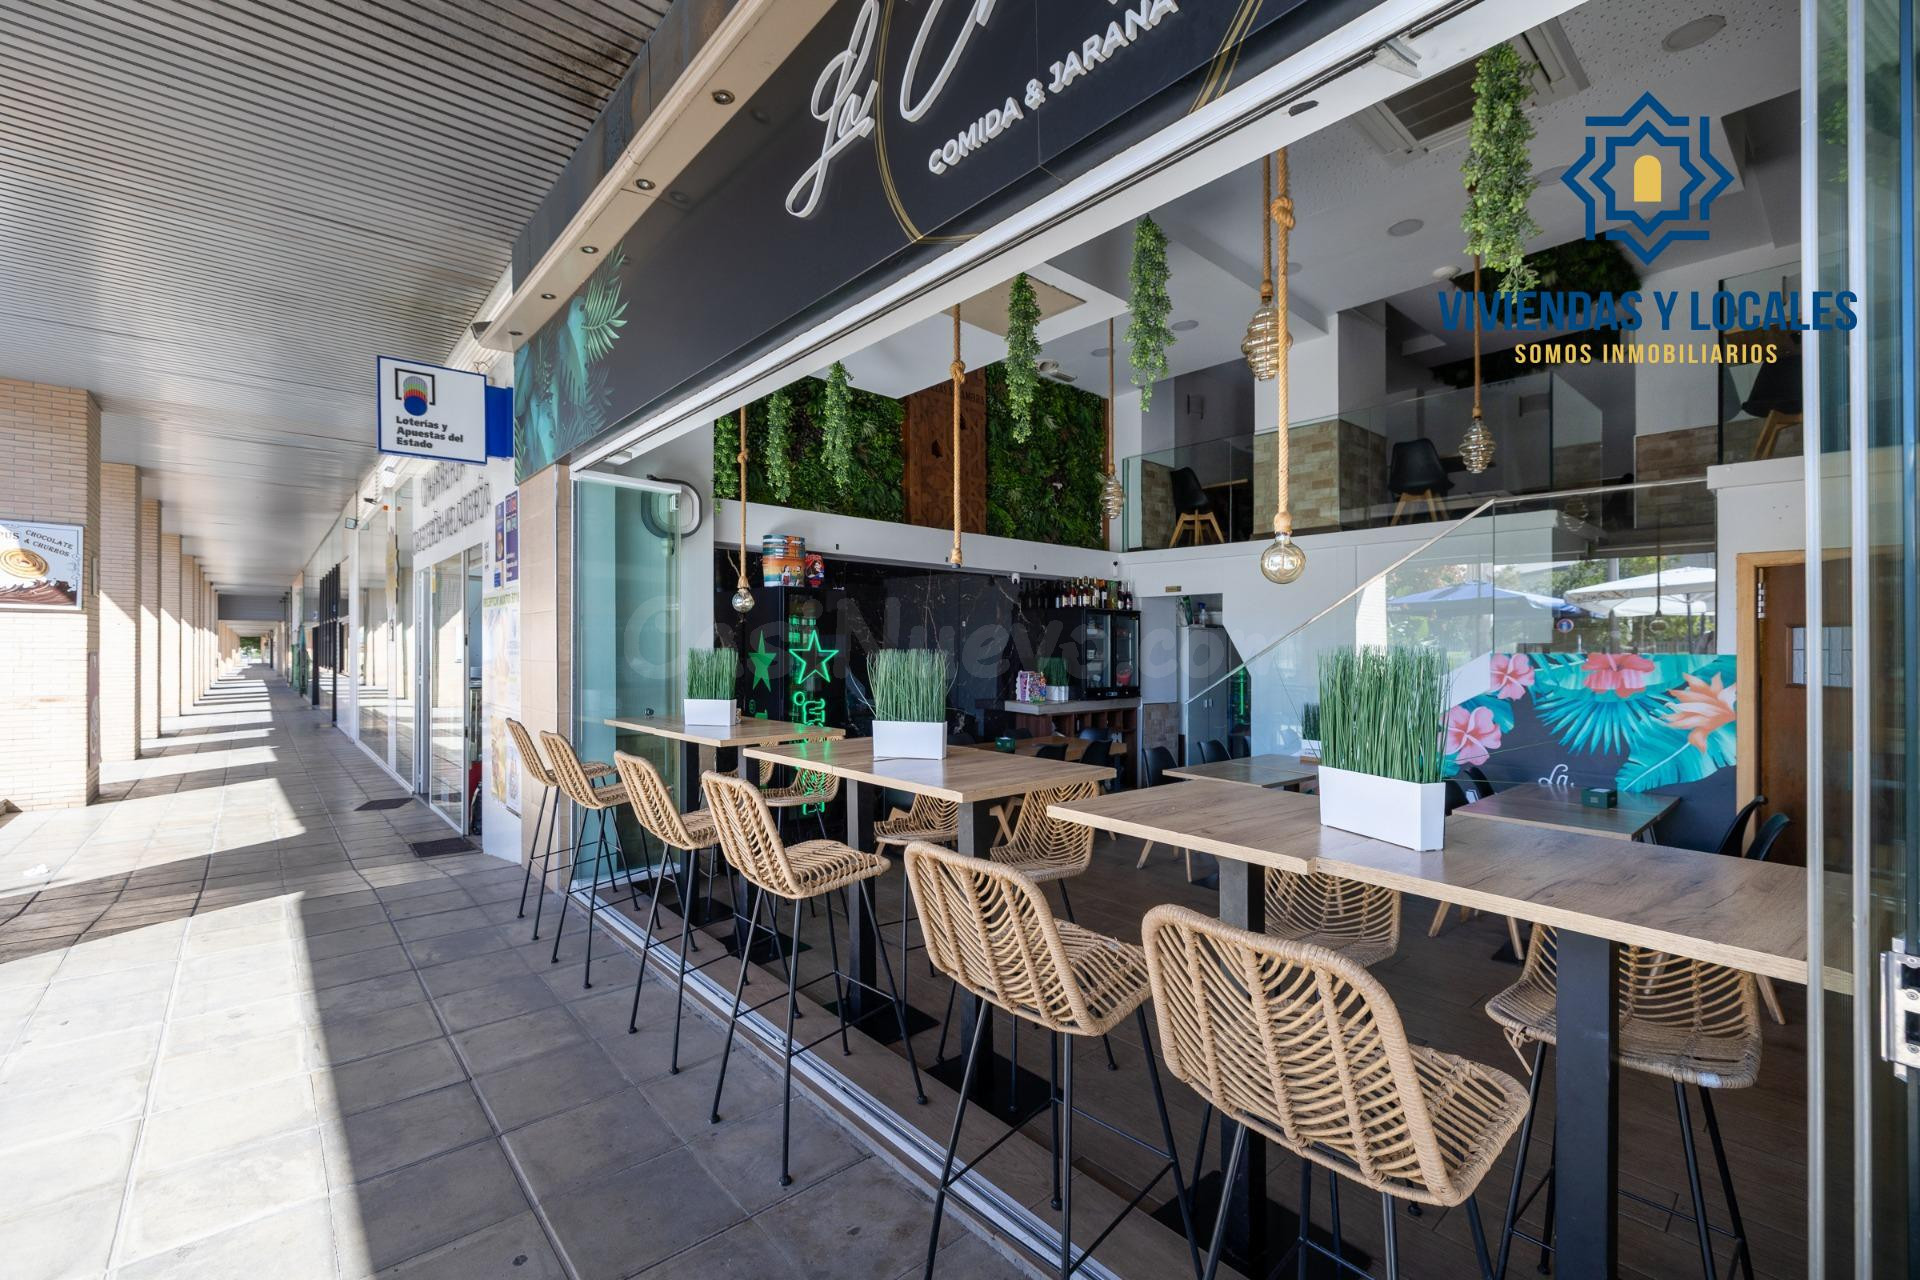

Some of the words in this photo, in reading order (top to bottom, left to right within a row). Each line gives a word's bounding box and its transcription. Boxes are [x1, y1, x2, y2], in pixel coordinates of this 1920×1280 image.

[928, 96, 1023, 175] COMIDA
[1024, 78, 1046, 110] &
[1048, 0, 1179, 94] JARANA
[396, 416, 439, 429] Loterías
[441, 423, 448, 432] y
[397, 426, 445, 440] Apuestas
[448, 433, 464, 443] del
[396, 437, 433, 449] Estado
[25, 529, 74, 550] CHOCOLATE
[32, 541, 70, 557] CHURROS
